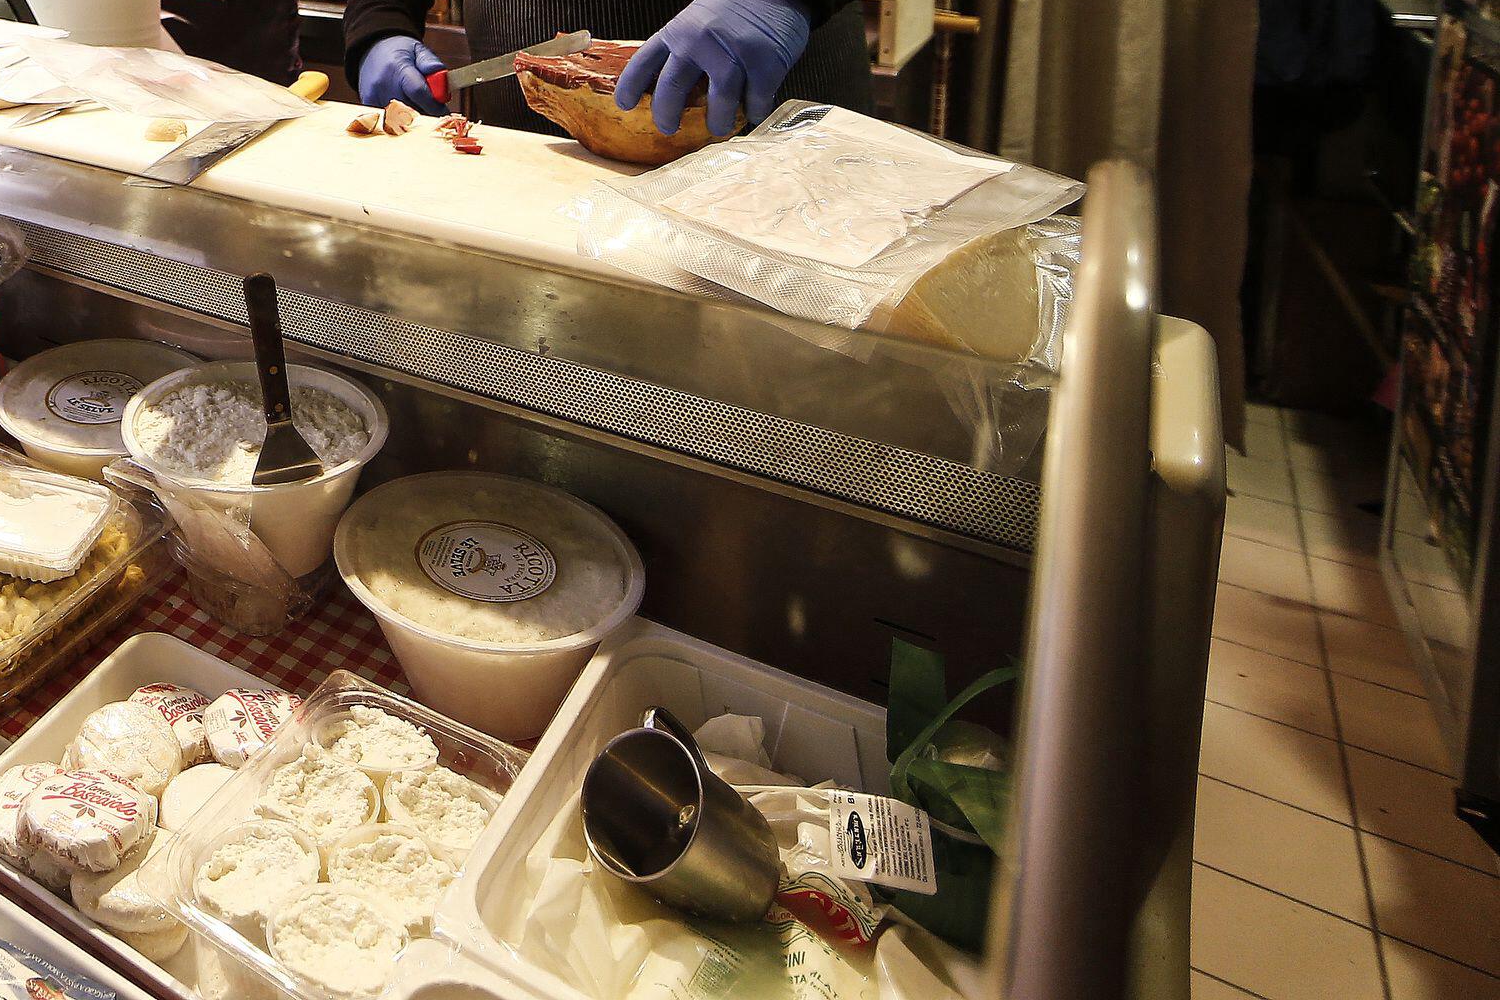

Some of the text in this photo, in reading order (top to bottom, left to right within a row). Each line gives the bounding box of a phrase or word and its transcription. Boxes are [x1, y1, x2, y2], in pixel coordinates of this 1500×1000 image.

[459, 537, 479, 548] LE
[451, 548, 467, 578] SELVE
[499, 541, 544, 595] RICOTTA
[63, 780, 140, 818] Boscaiolo
